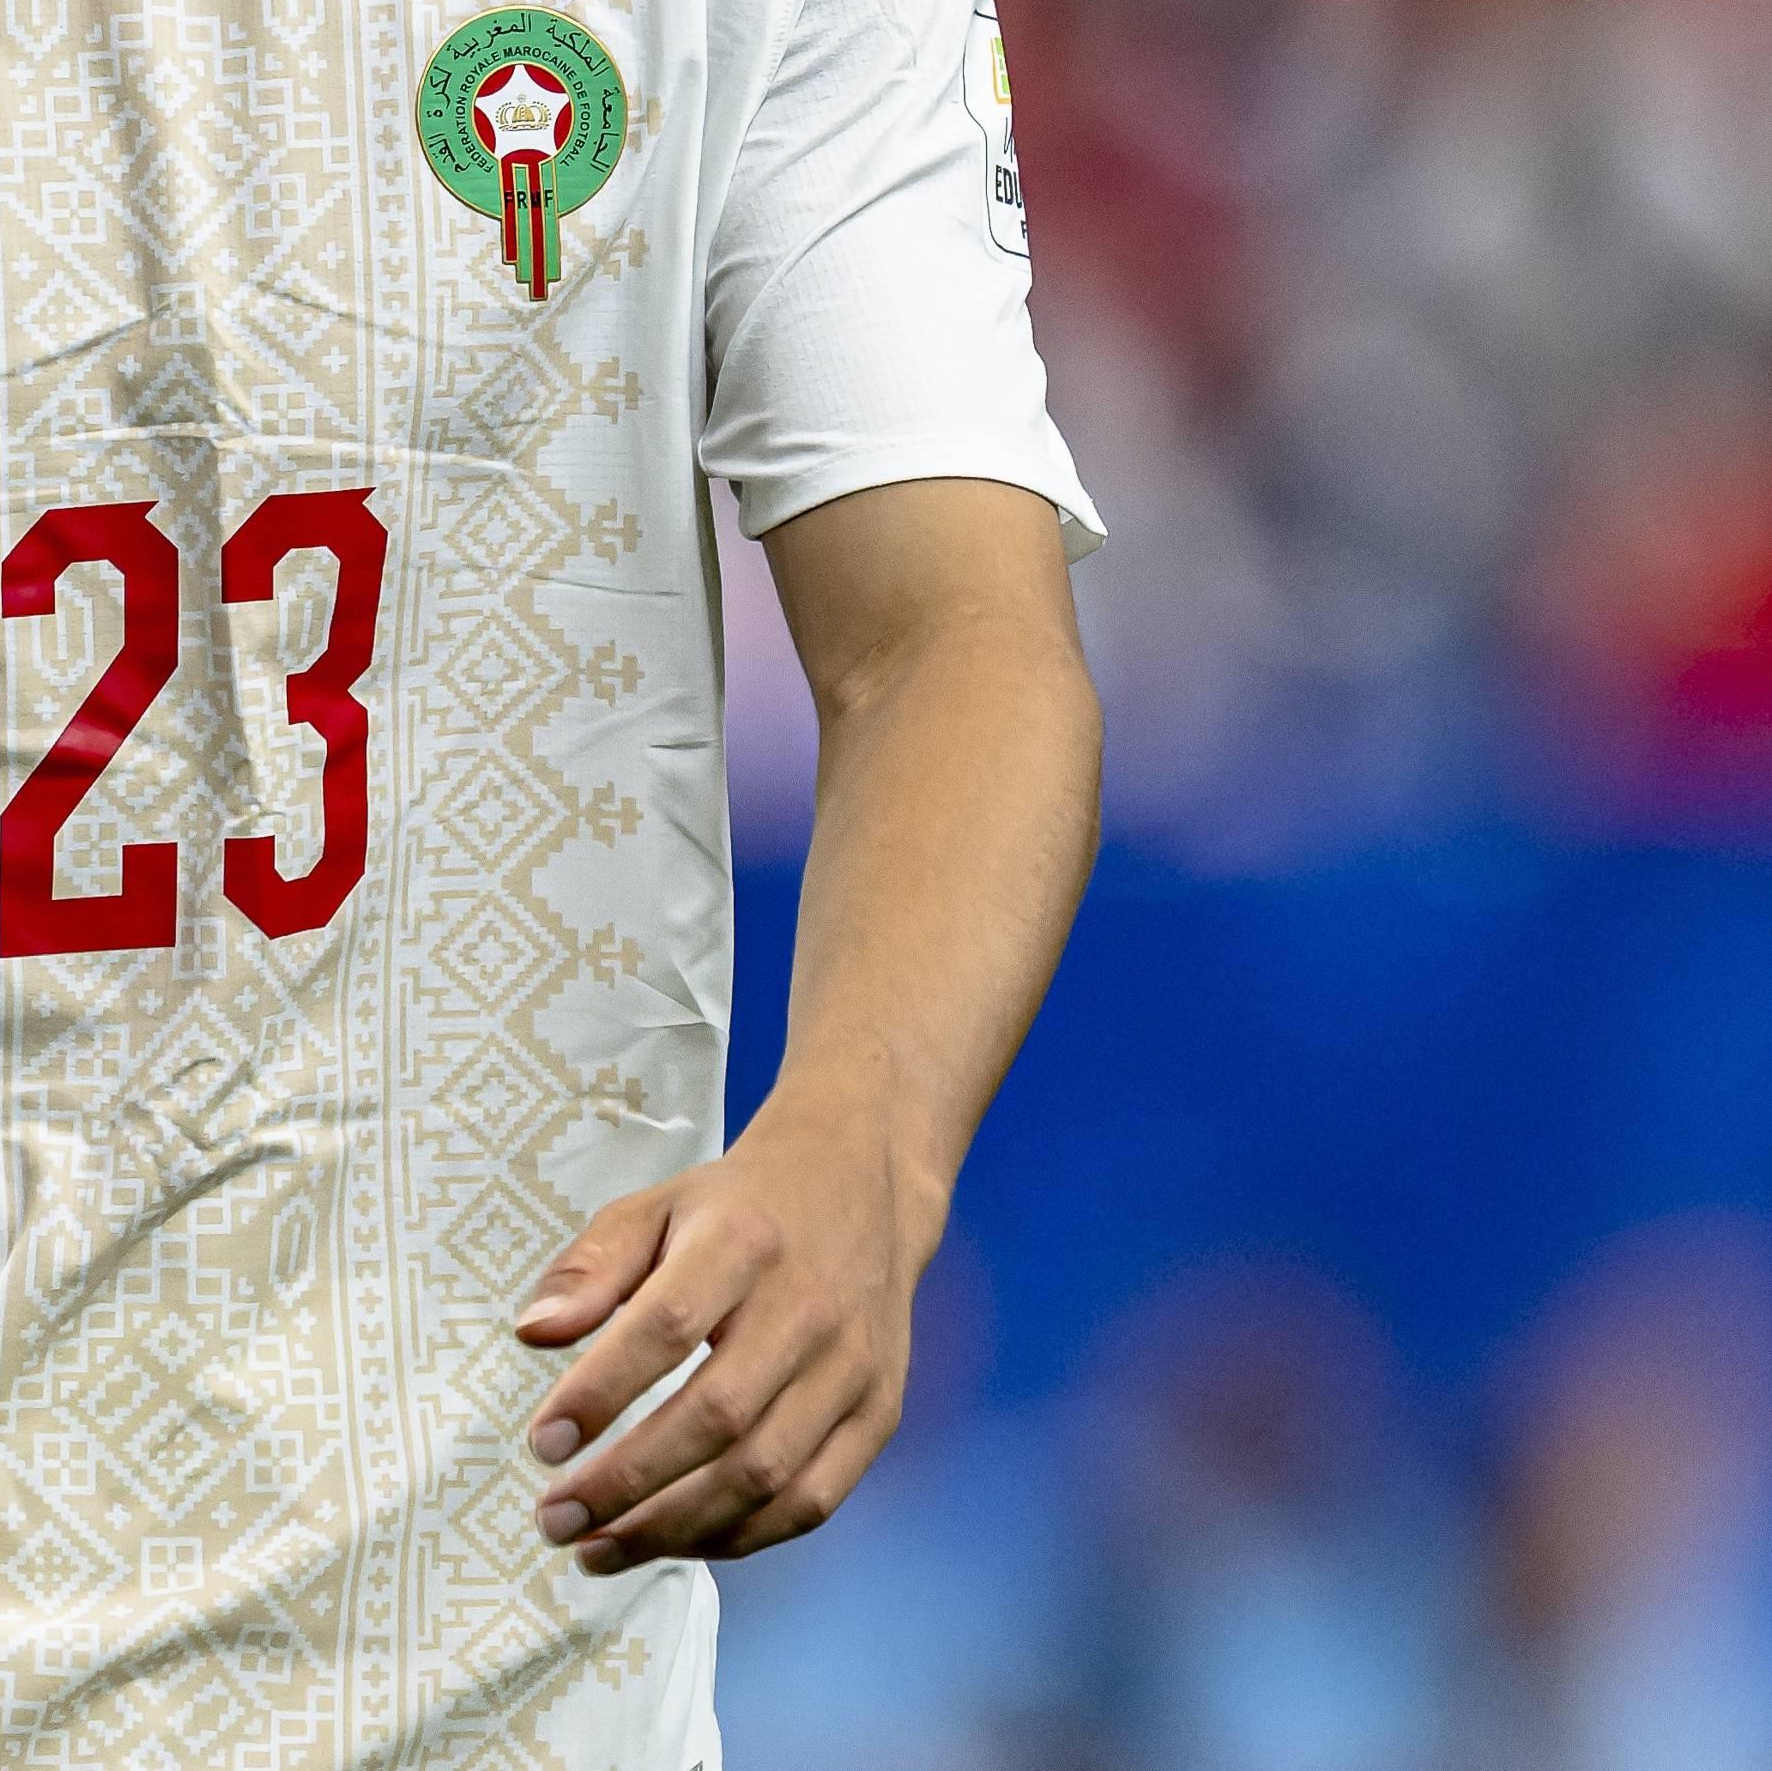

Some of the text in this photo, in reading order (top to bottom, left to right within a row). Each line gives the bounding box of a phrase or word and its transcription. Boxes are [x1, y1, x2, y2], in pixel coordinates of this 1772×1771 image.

[426, 13, 620, 173] الجامعة الملكية المغربية لكرة القدم
[455, 46, 591, 173] FEDERATION ROYALE MAROCAINE DE FOOTBALL
[0, 487, 388, 959] 23
